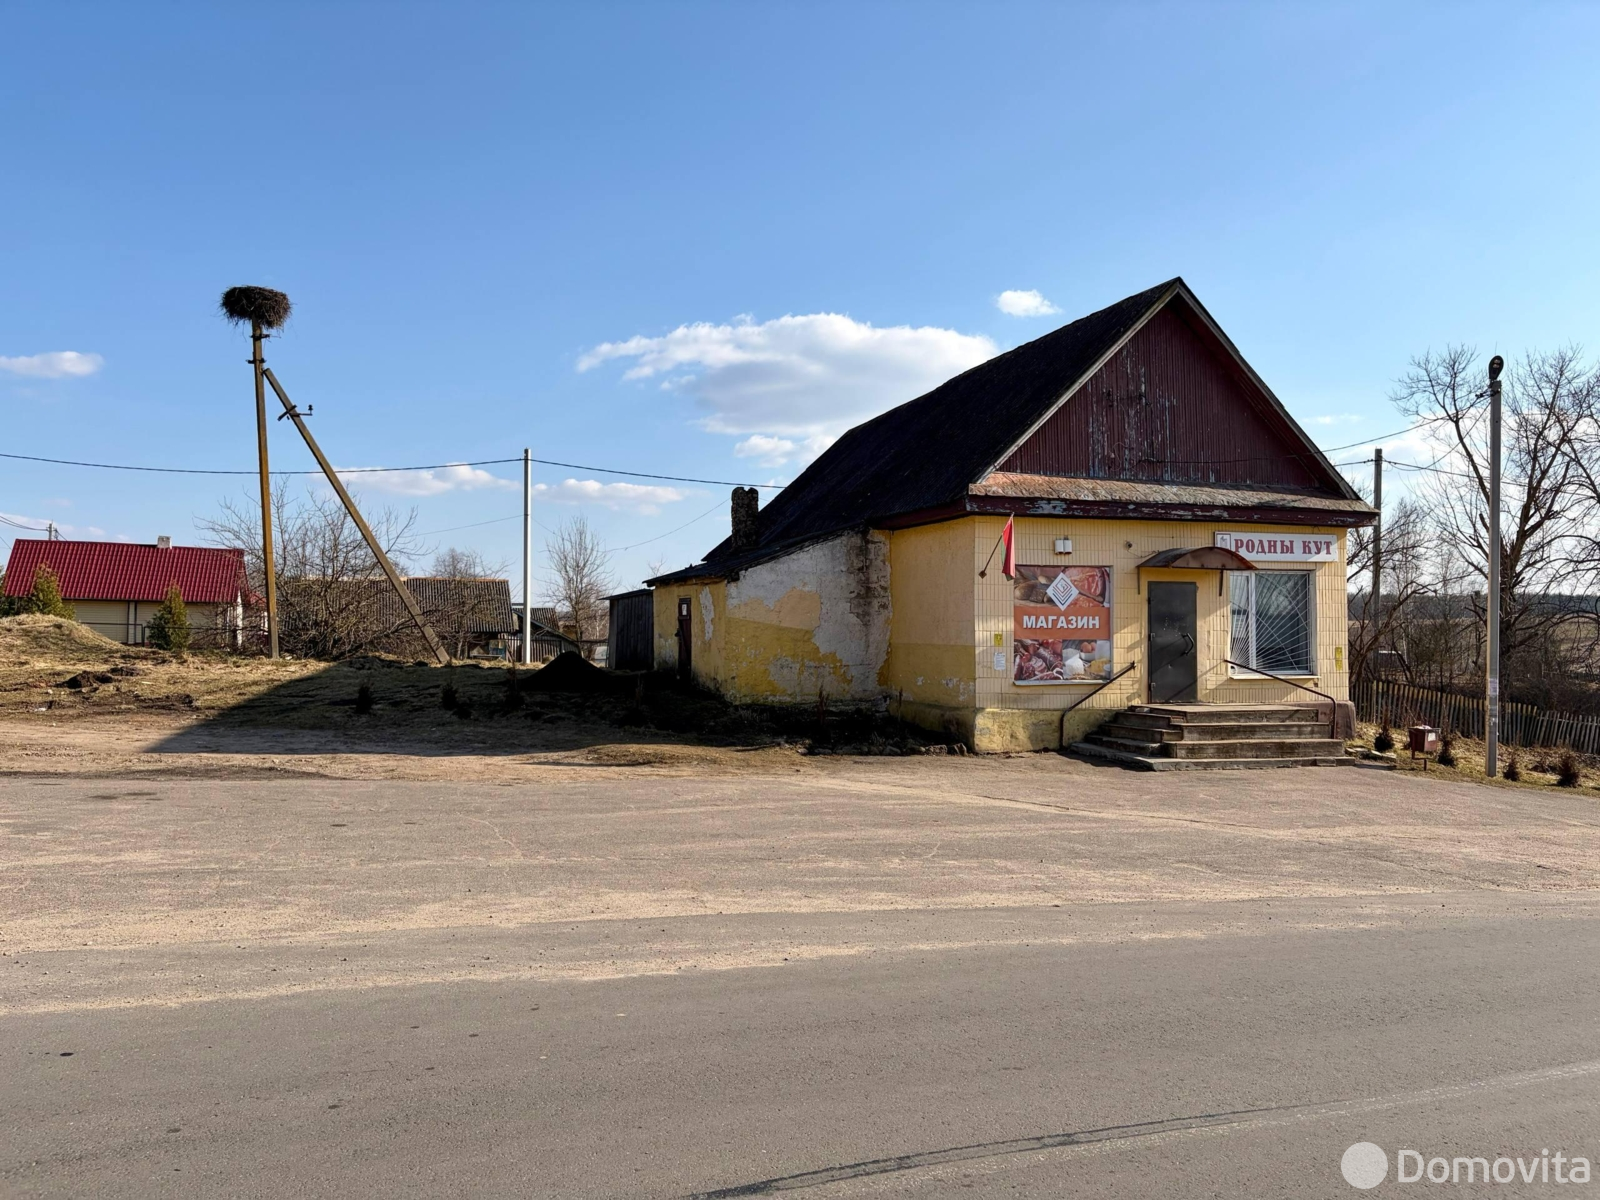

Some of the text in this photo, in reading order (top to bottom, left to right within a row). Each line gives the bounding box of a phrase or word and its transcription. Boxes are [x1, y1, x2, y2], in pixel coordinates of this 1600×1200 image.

[1234, 538, 1333, 555] РОДНЫ КУТ
[1023, 615, 1100, 629] МАГАЗИН
